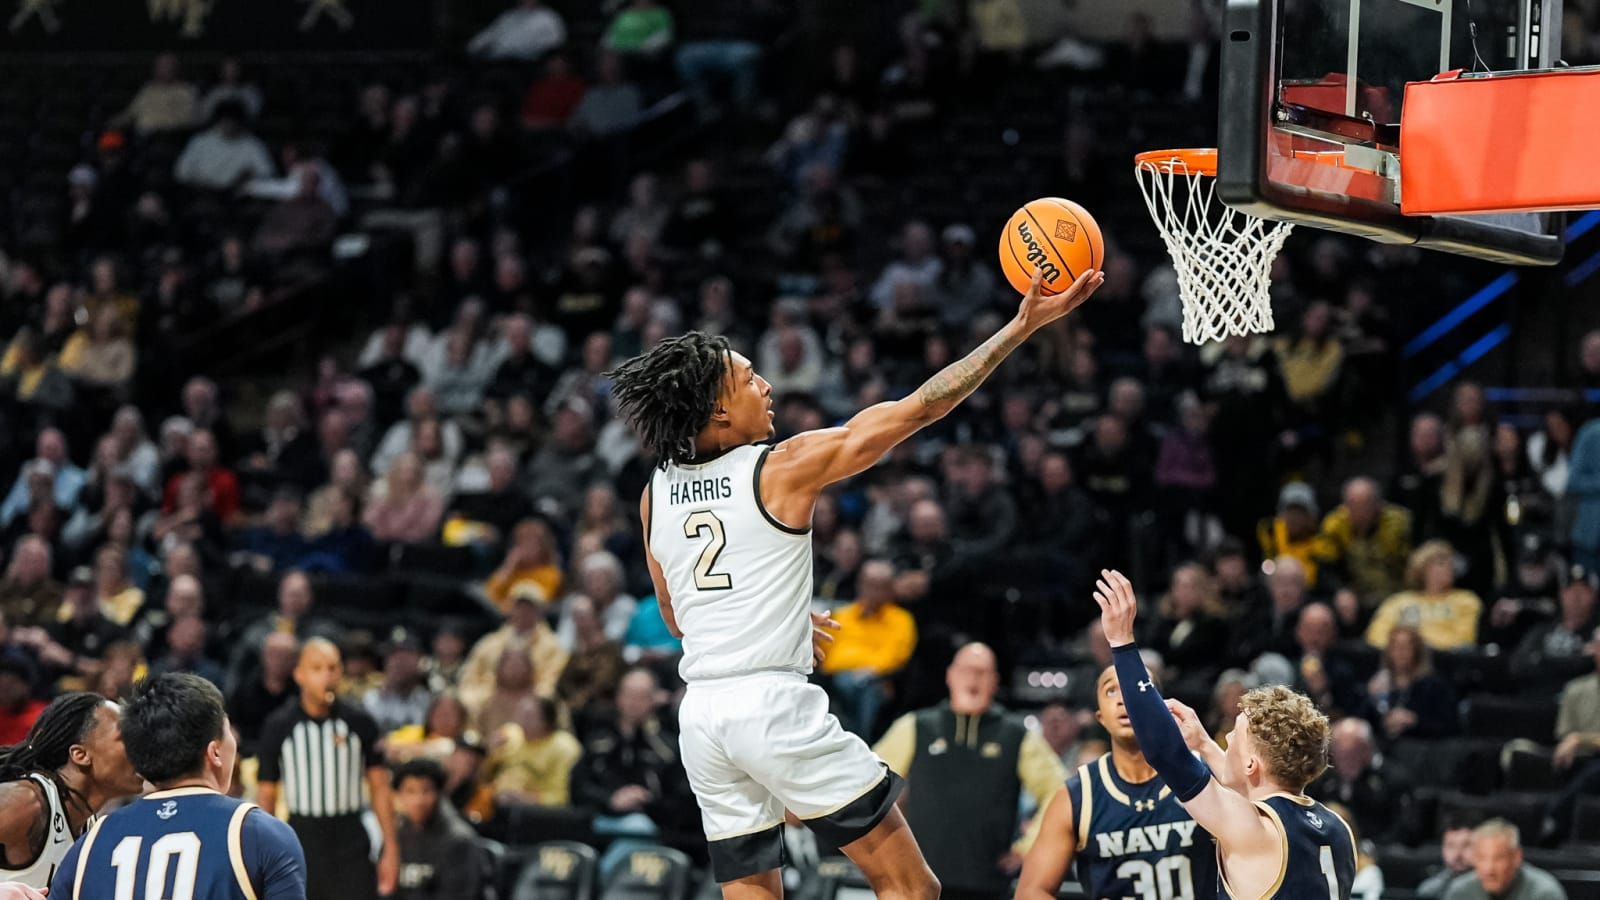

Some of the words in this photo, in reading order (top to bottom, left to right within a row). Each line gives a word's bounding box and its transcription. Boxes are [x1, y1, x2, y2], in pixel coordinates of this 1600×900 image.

[1018, 220, 1061, 285] Wilson
[670, 476, 732, 505] HARRIS
[683, 509, 733, 591] 2
[110, 831, 202, 900] 10
[1095, 820, 1198, 858] NAVY
[1116, 854, 1195, 900] 30
[1319, 845, 1340, 900] 1
